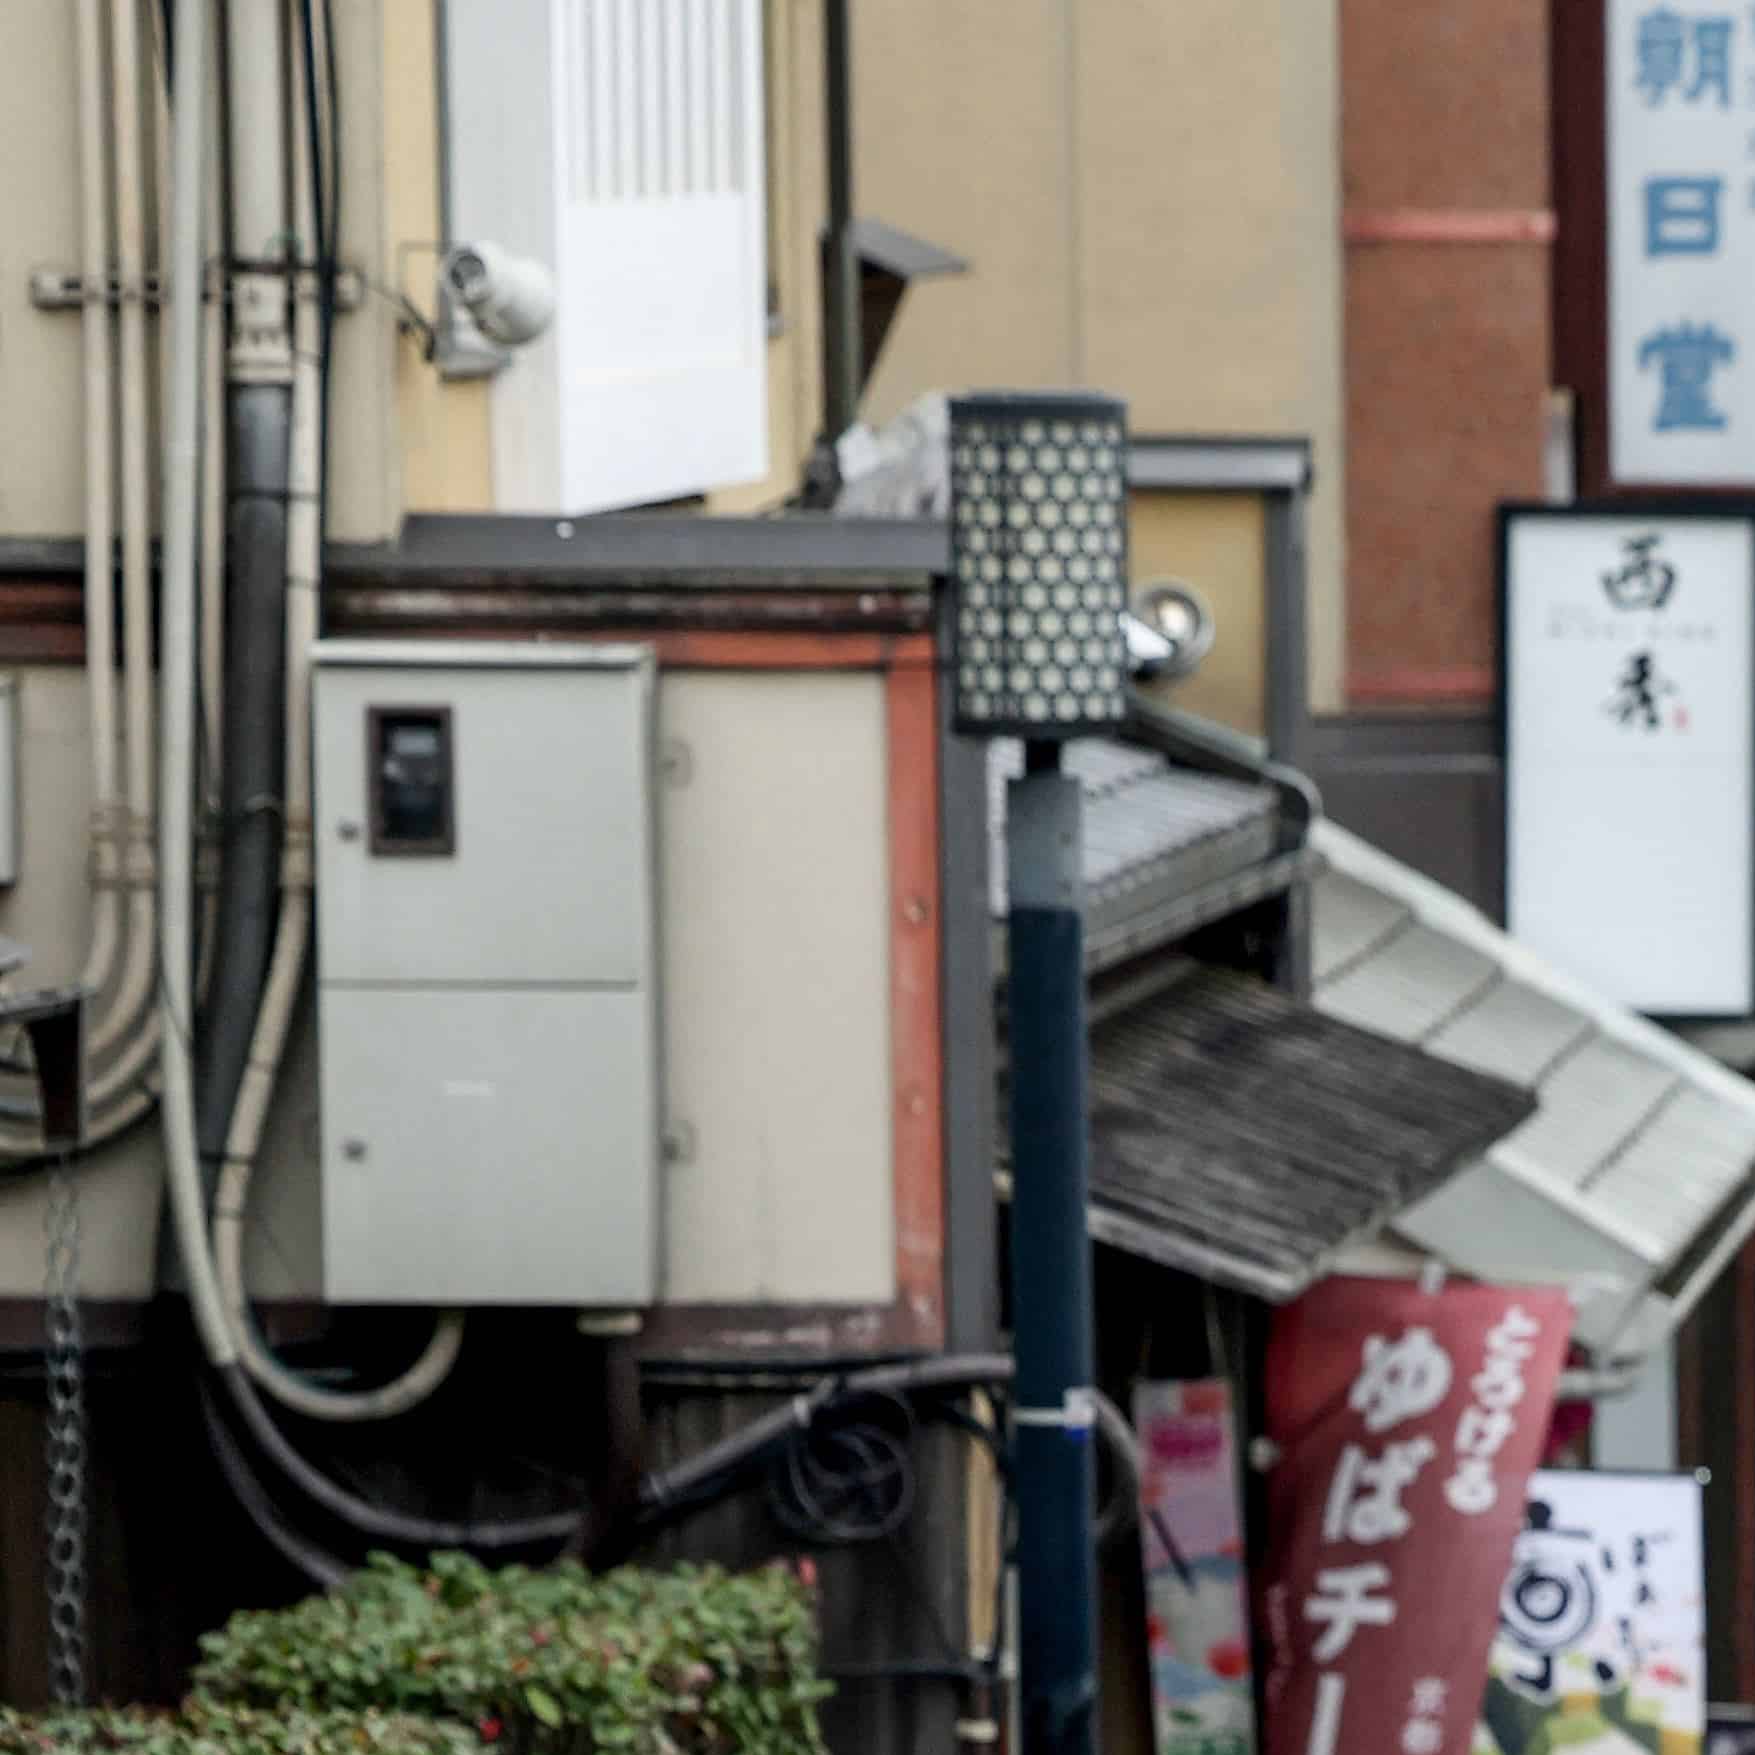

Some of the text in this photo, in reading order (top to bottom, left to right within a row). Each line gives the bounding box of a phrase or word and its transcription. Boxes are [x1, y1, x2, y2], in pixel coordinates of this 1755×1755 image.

[1634, 5, 1737, 434] 朝日堂
[1443, 1305, 1543, 1514] とろける
